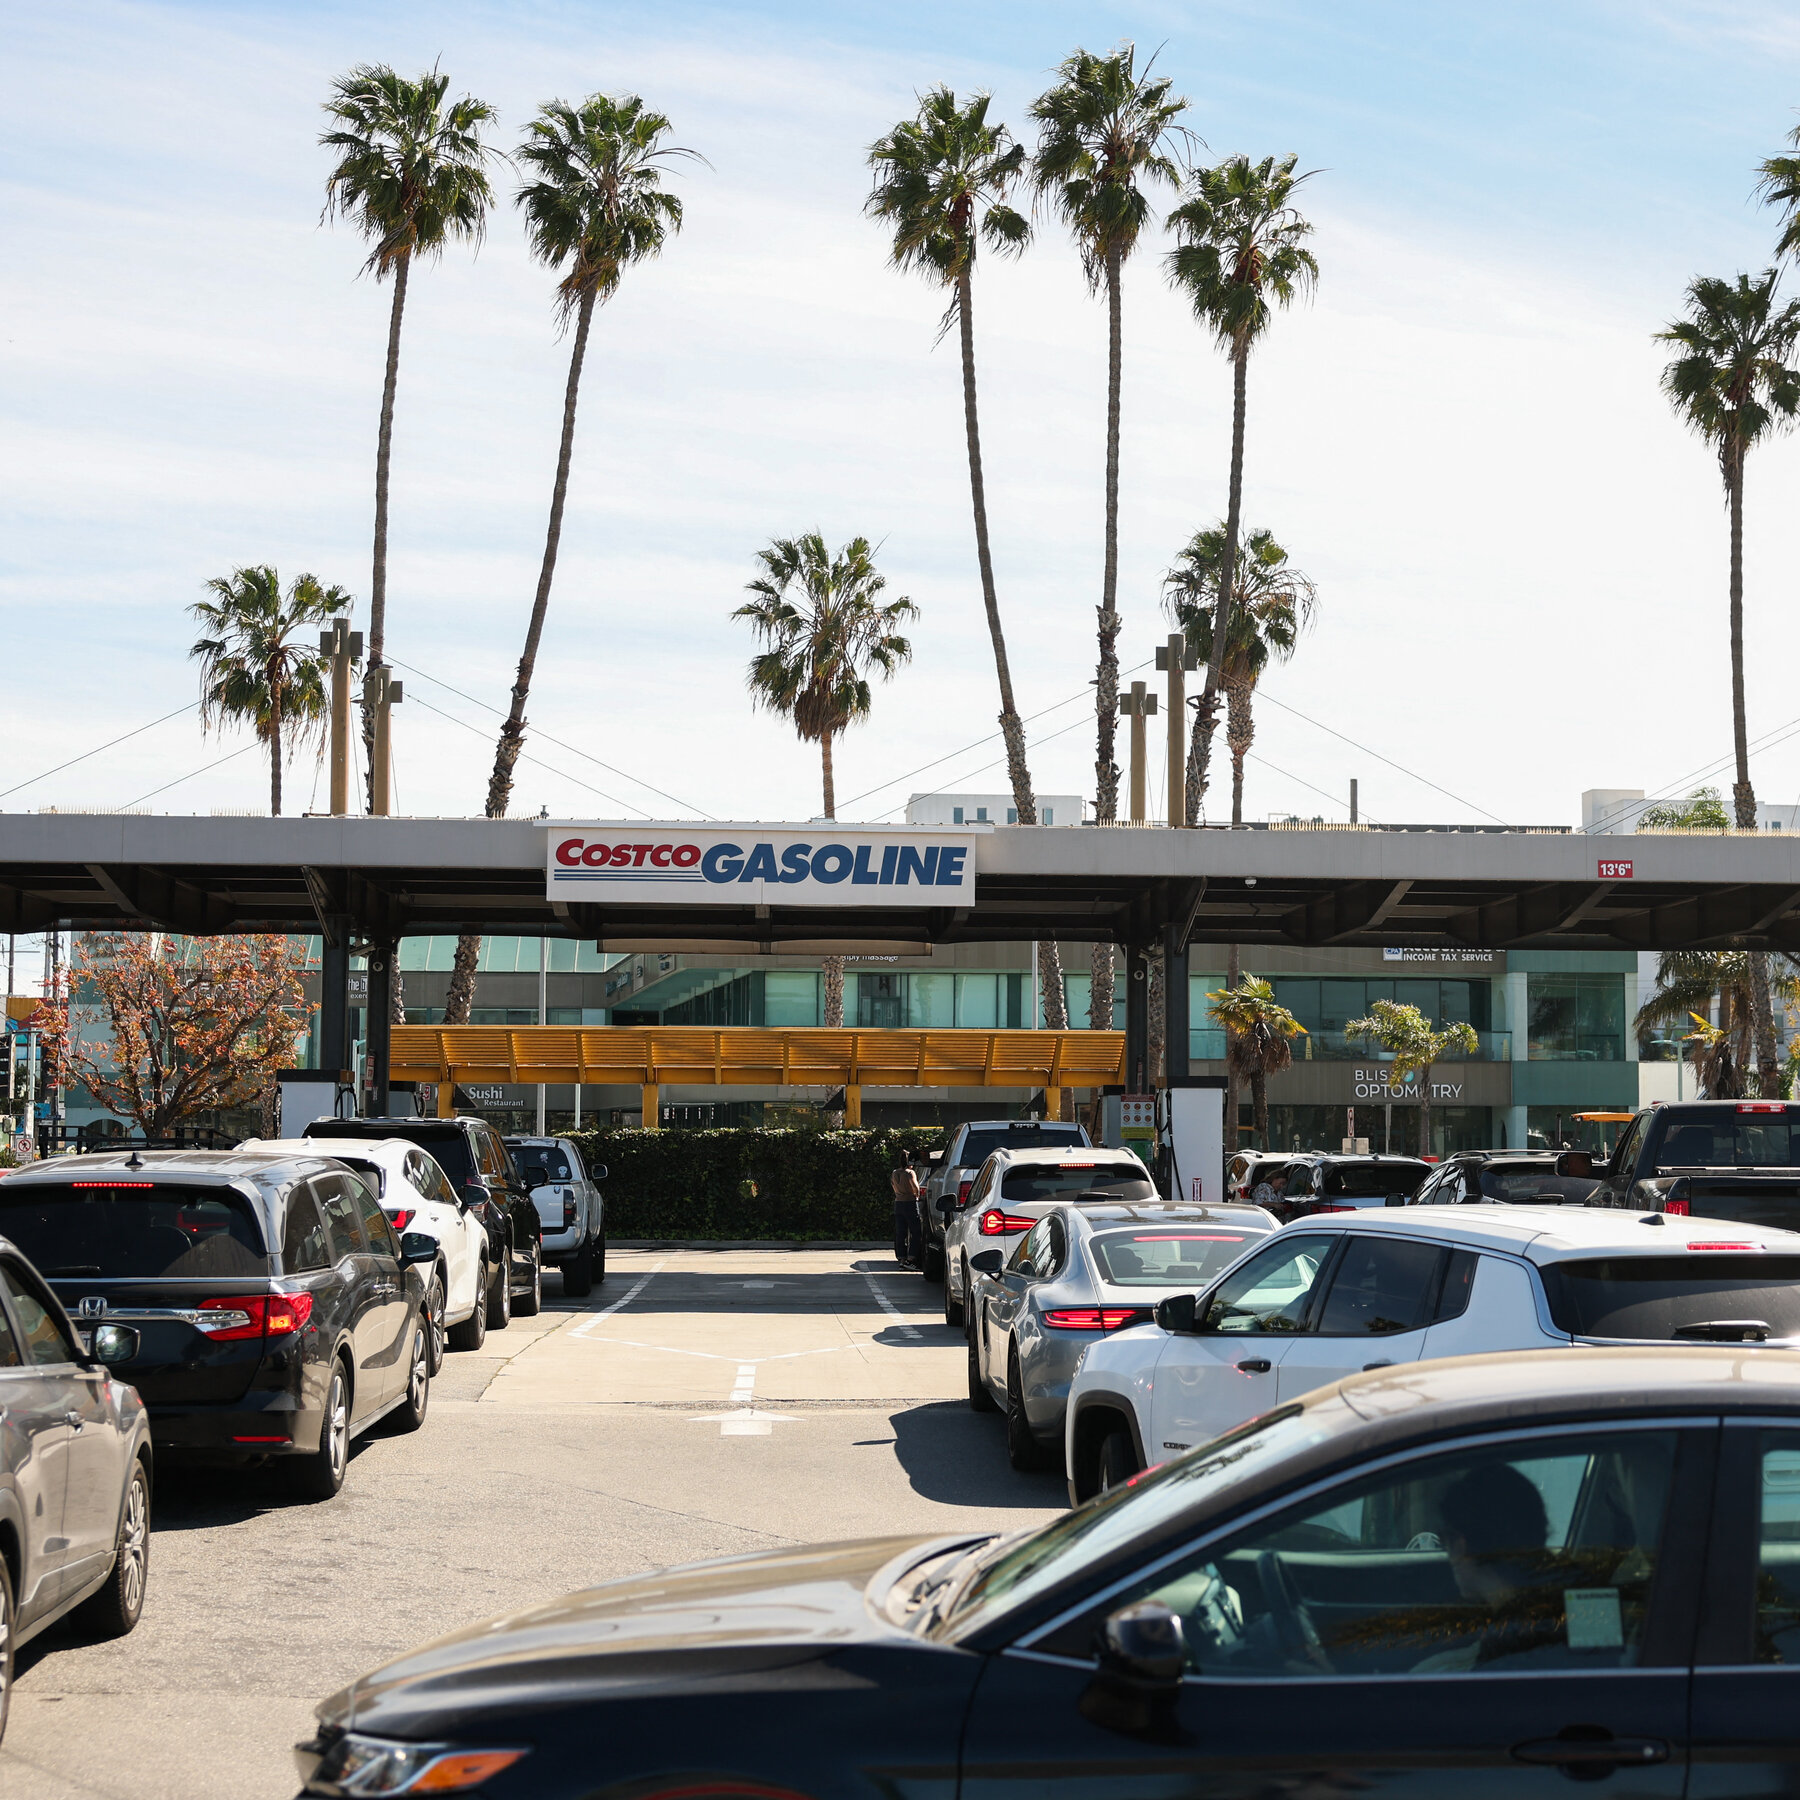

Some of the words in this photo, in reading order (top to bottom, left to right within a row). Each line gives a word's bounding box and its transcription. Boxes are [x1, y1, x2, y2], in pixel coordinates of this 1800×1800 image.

[555, 838, 702, 868] COSTCO
[701, 843, 968, 886] GASOLINE
[1600, 863, 1631, 876] 13'6"
[1403, 953, 1436, 961] INCOME
[1441, 953, 1457, 961] TAX
[1461, 953, 1493, 961] SERVICE
[1355, 1069, 1388, 1081] BLIS
[468, 1086, 503, 1100] Sushi
[1355, 1083, 1462, 1098] OPTOMTRY
[484, 1099, 524, 1107] Restaurant
